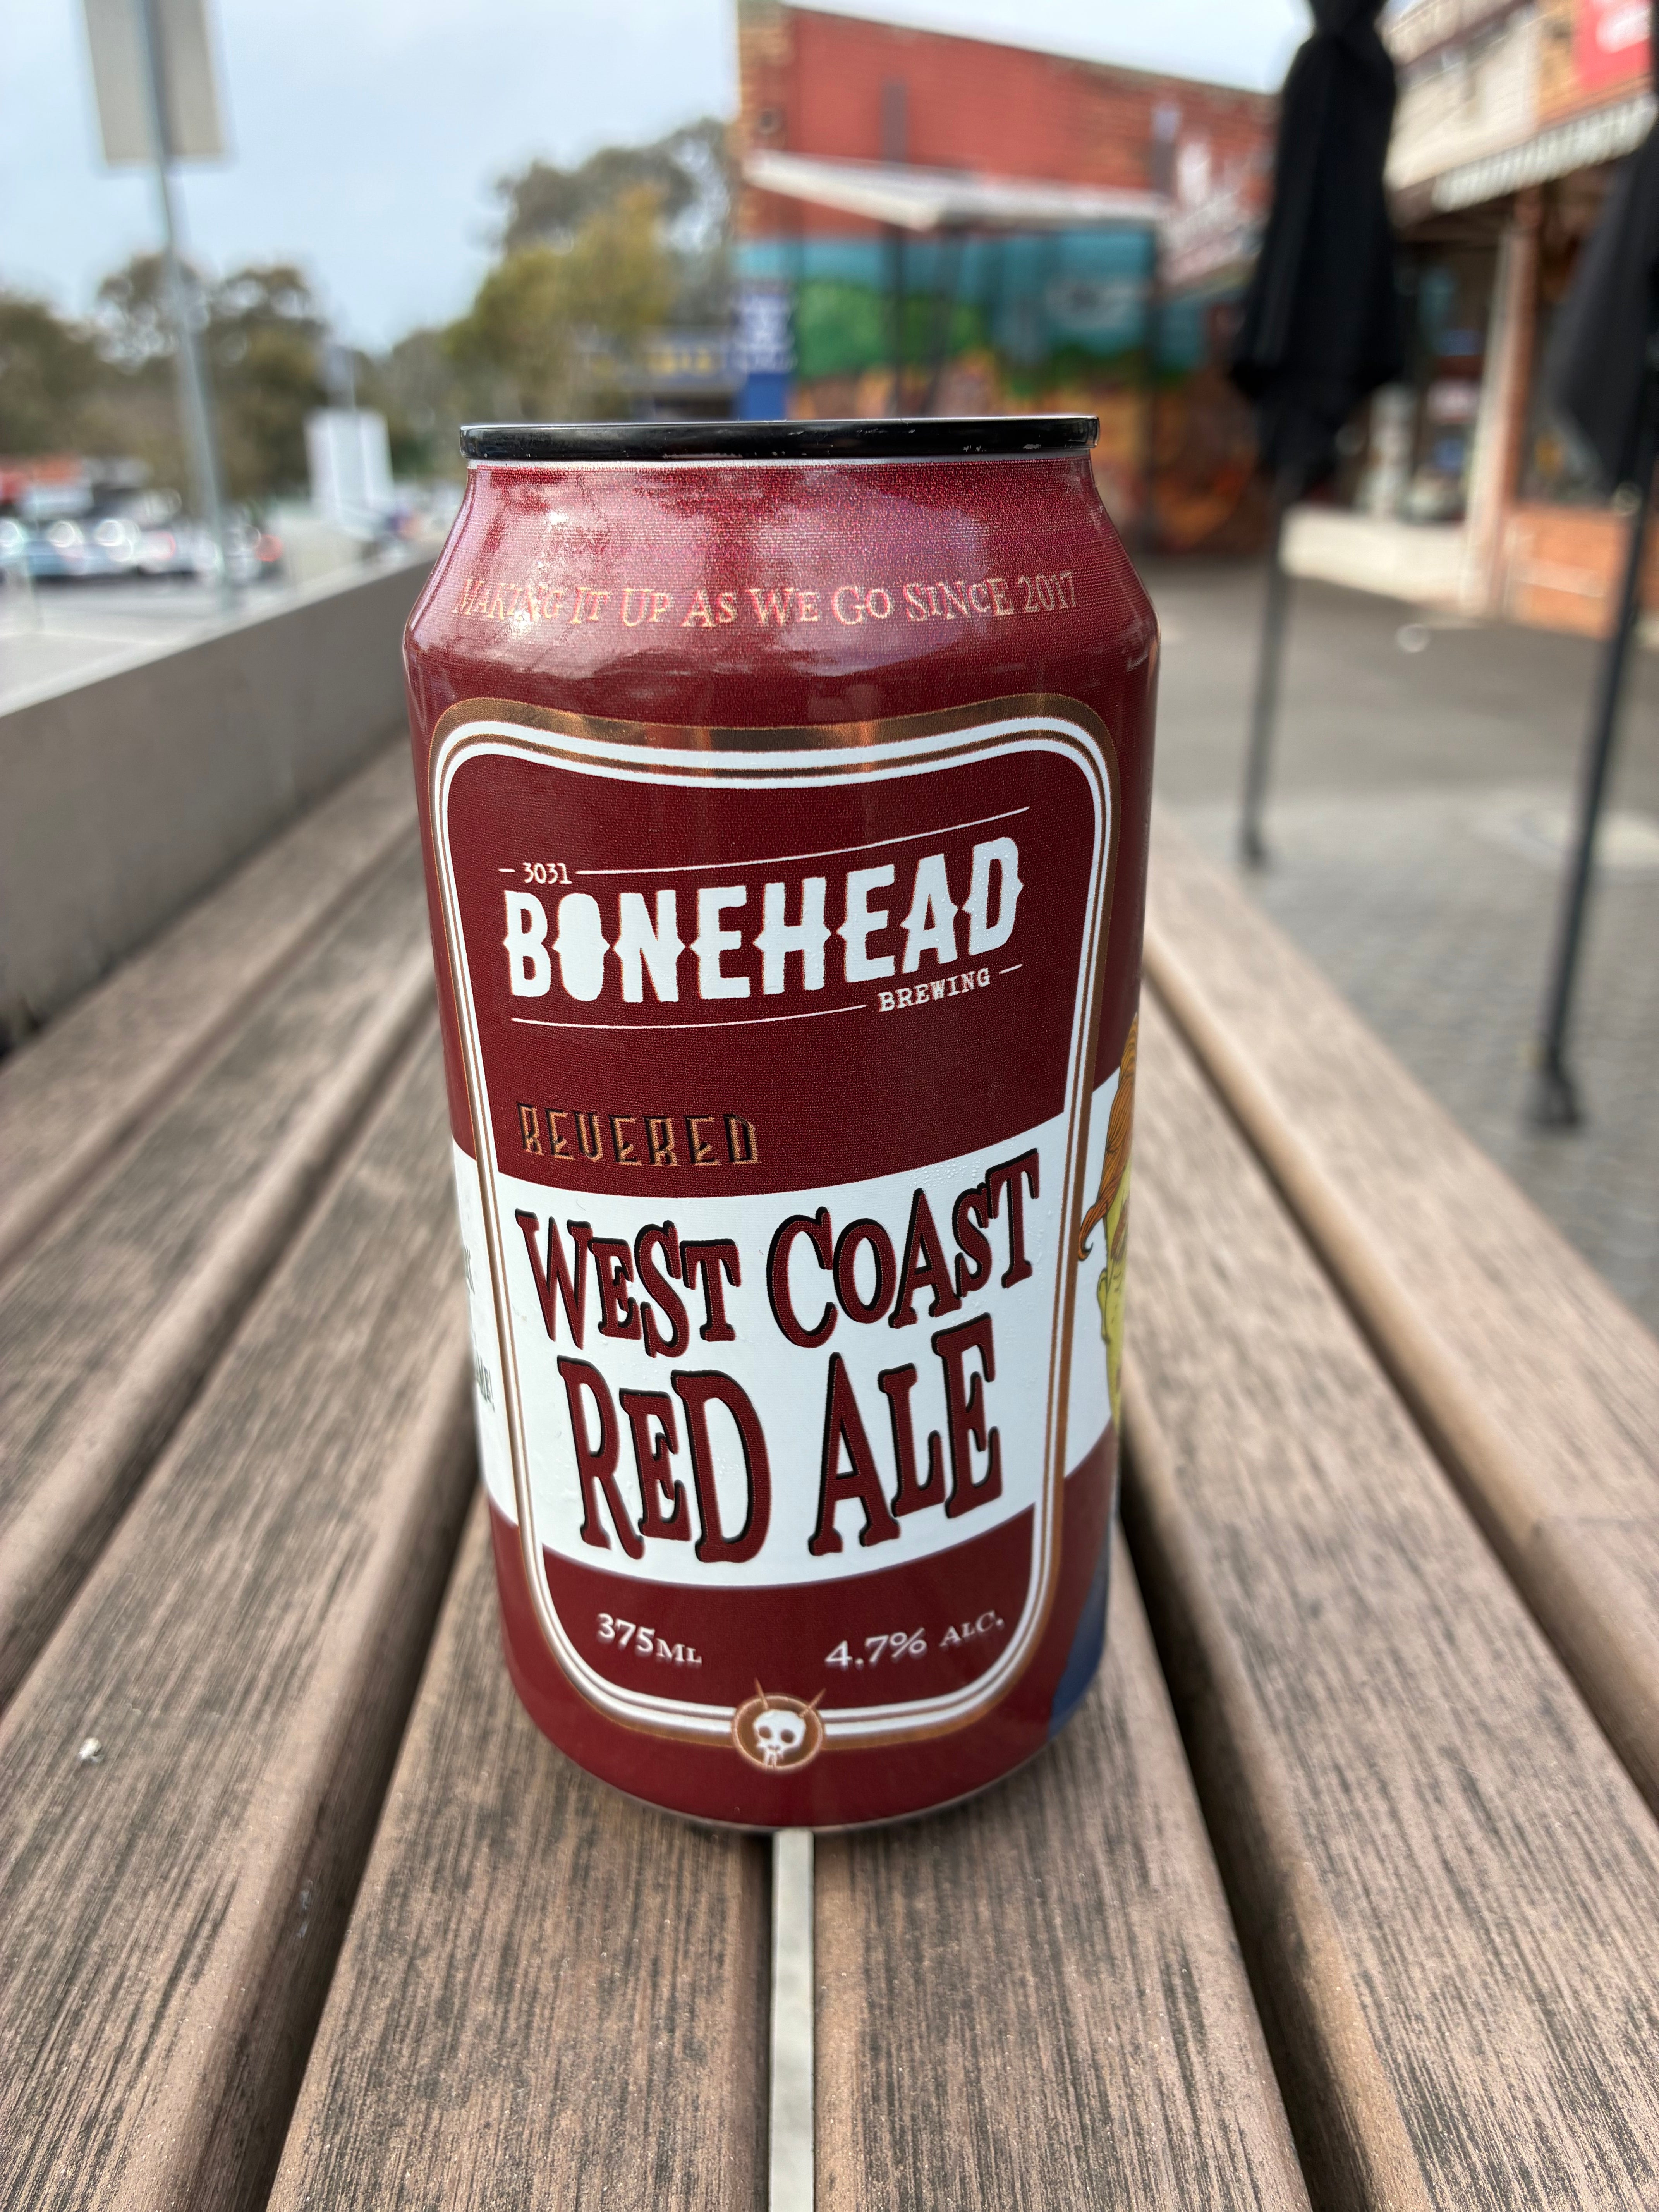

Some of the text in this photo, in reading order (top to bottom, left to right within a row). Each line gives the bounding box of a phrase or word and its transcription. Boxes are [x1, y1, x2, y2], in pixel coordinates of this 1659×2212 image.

[570, 587, 609, 625] IT
[622, 587, 672, 628] UP
[682, 588, 737, 628] AS
[746, 587, 819, 627] WE
[831, 586, 891, 625] GO
[903, 577, 1013, 621] SINCE
[1019, 570, 1077, 613] 2017
[522, 862, 573, 885] 3031
[502, 837, 1024, 1003] BONEHEAD
[878, 967, 990, 1013] BREWING
[517, 1103, 761, 1167] REVERED
[515, 1147, 1040, 1358] WEST COAST
[557, 1312, 1003, 1563] RED ALE
[824, 1609, 1005, 1669] 4.7% ALC.
